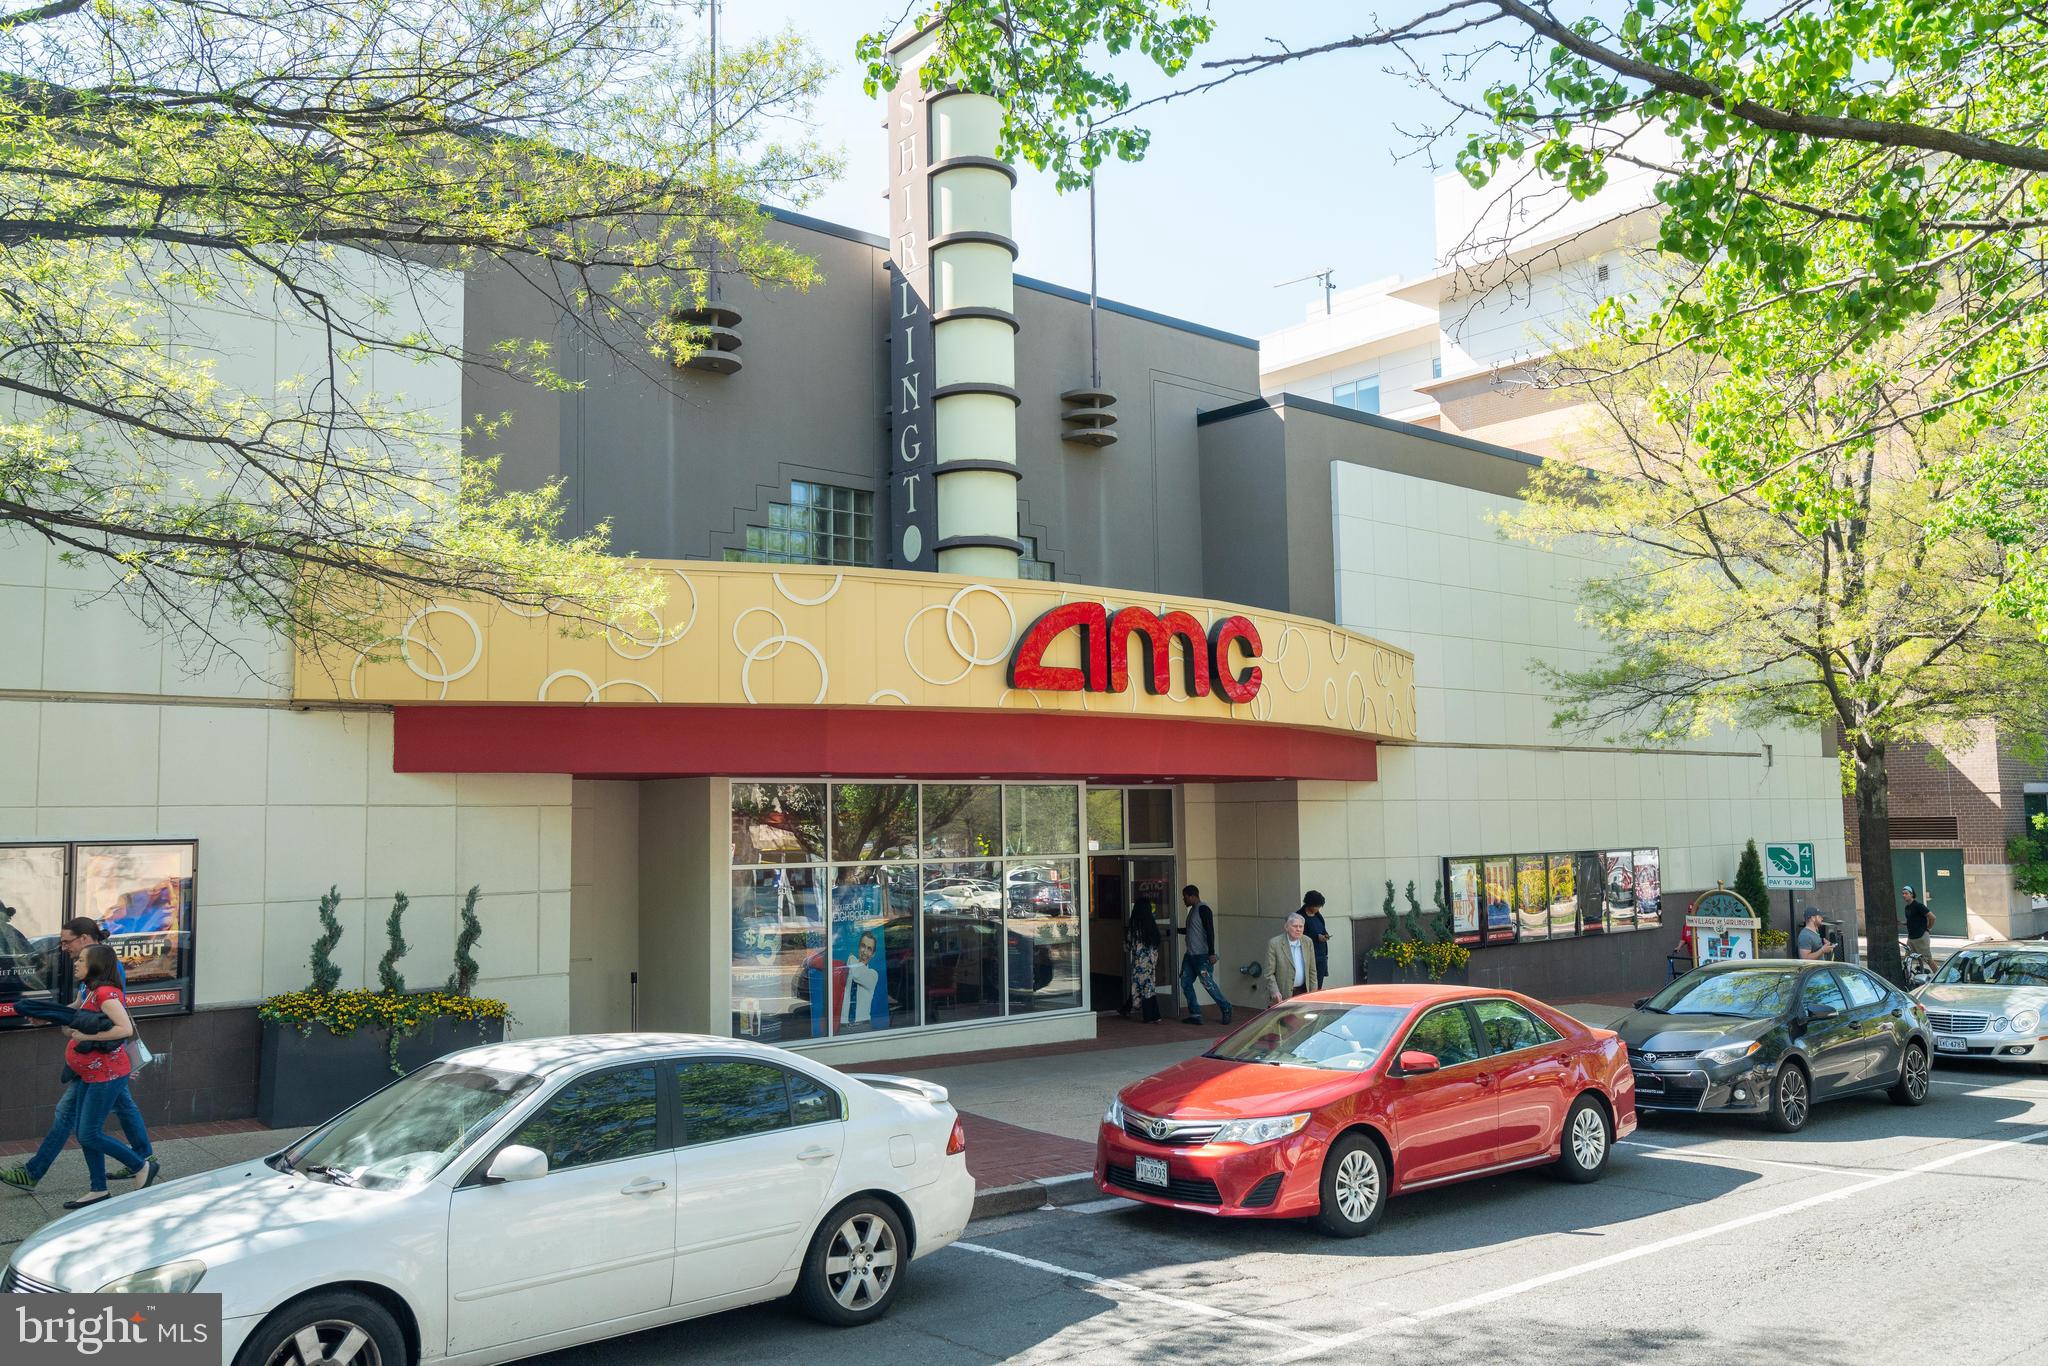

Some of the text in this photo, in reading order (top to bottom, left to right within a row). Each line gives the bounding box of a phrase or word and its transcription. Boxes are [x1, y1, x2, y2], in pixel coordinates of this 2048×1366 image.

[1799, 846, 1811, 858] 4
[833, 910, 870, 922] EIGHBOR?
[113, 944, 165, 958] EIRUT
[137, 993, 176, 1003] SHOWING
